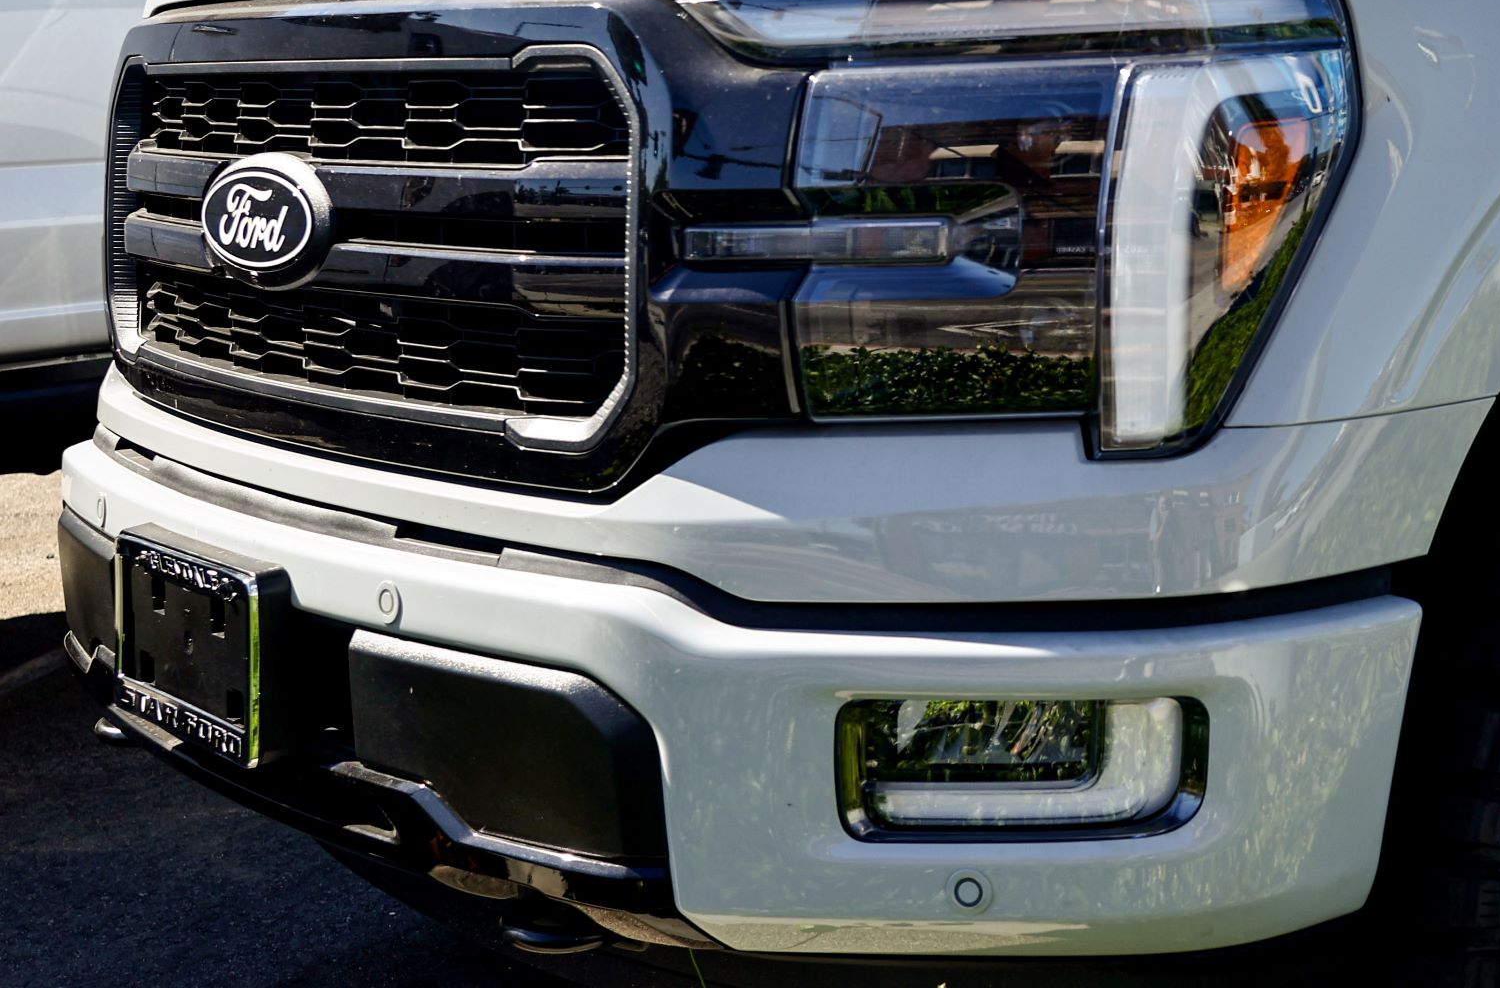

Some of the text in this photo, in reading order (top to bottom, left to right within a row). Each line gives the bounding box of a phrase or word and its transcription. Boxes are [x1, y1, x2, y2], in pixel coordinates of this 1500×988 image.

[219, 183, 289, 252] Ford
[120, 685, 242, 758] STAR FORD
